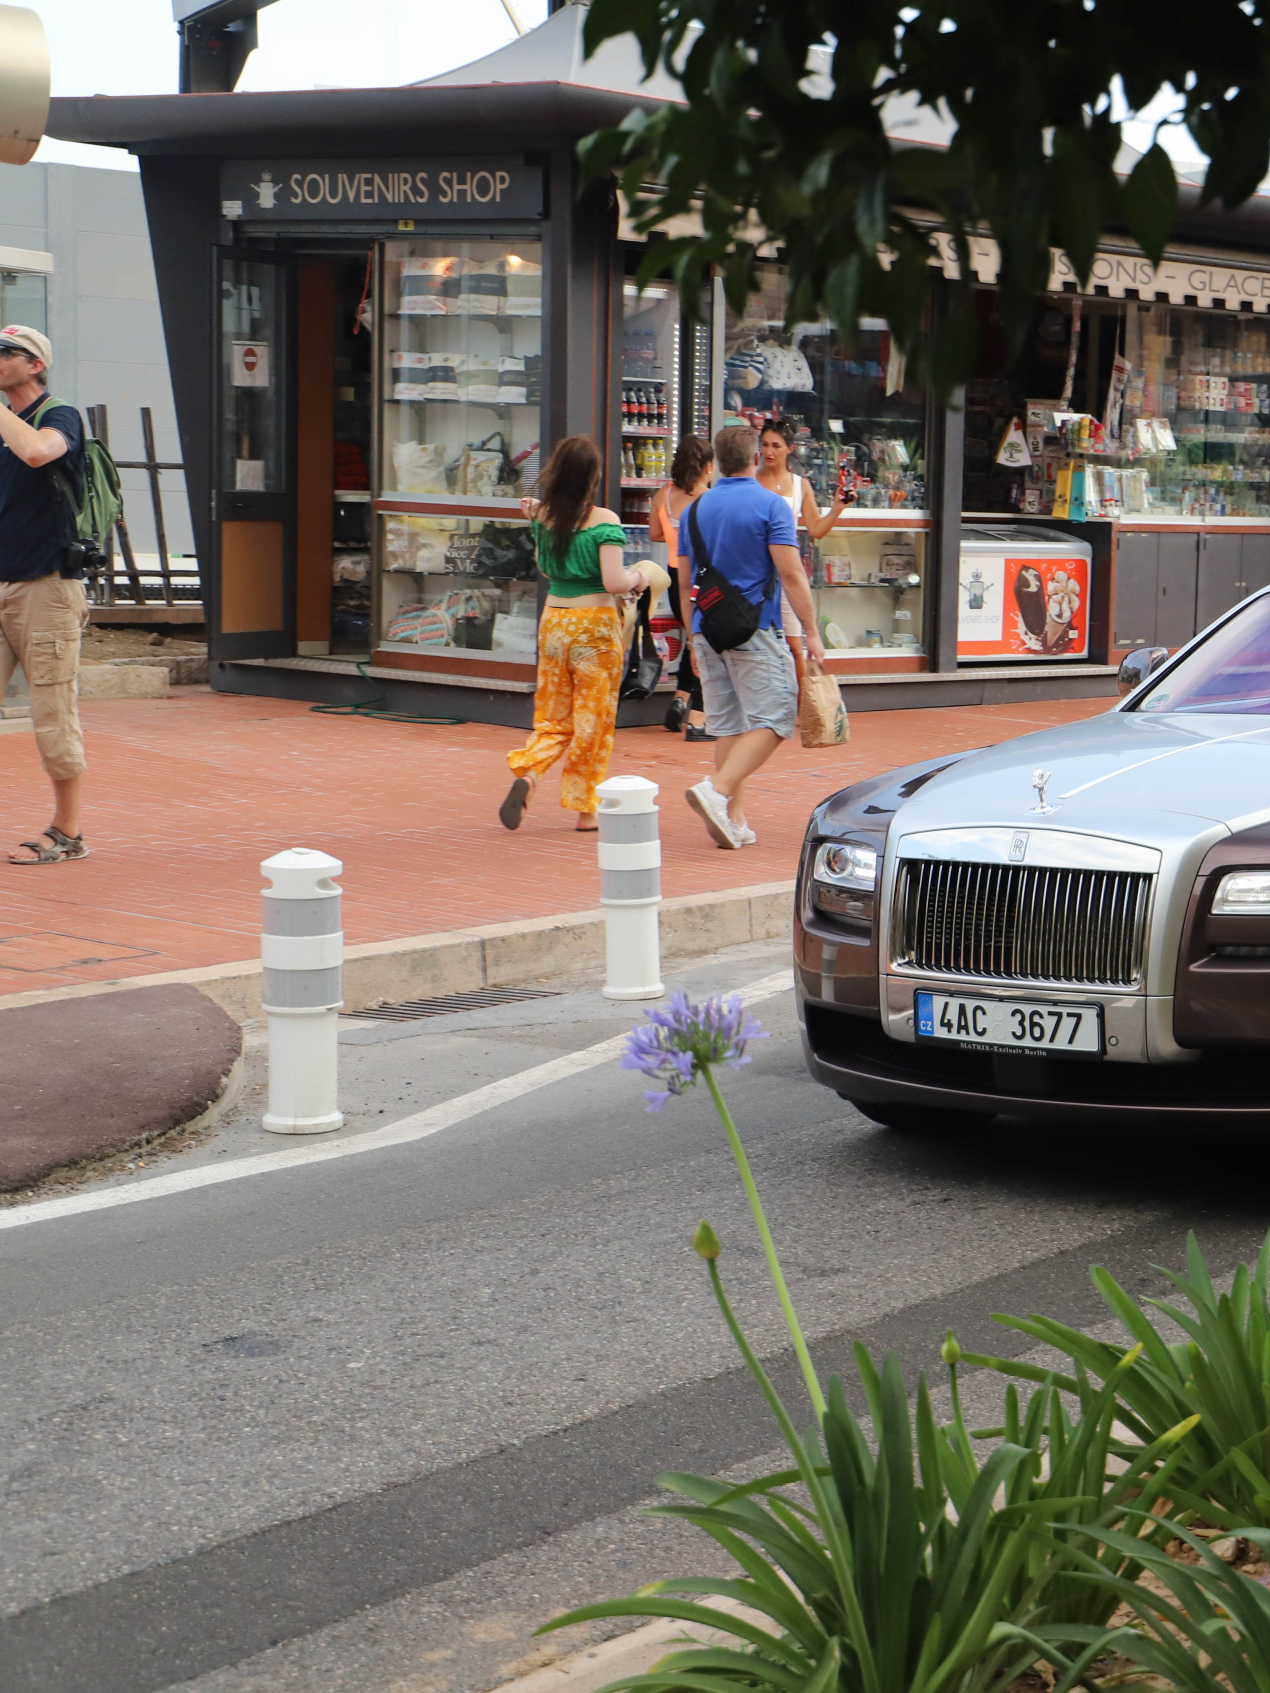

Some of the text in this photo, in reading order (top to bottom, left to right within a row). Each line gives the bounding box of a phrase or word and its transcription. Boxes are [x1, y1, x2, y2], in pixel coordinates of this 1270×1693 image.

[290, 171, 510, 204] SOUVENIRS SHOP
[920, 1020, 932, 1031] CZ
[939, 1001, 1083, 1045] 4AC 3677
[1024, 1048, 1047, 1056] Berlin
